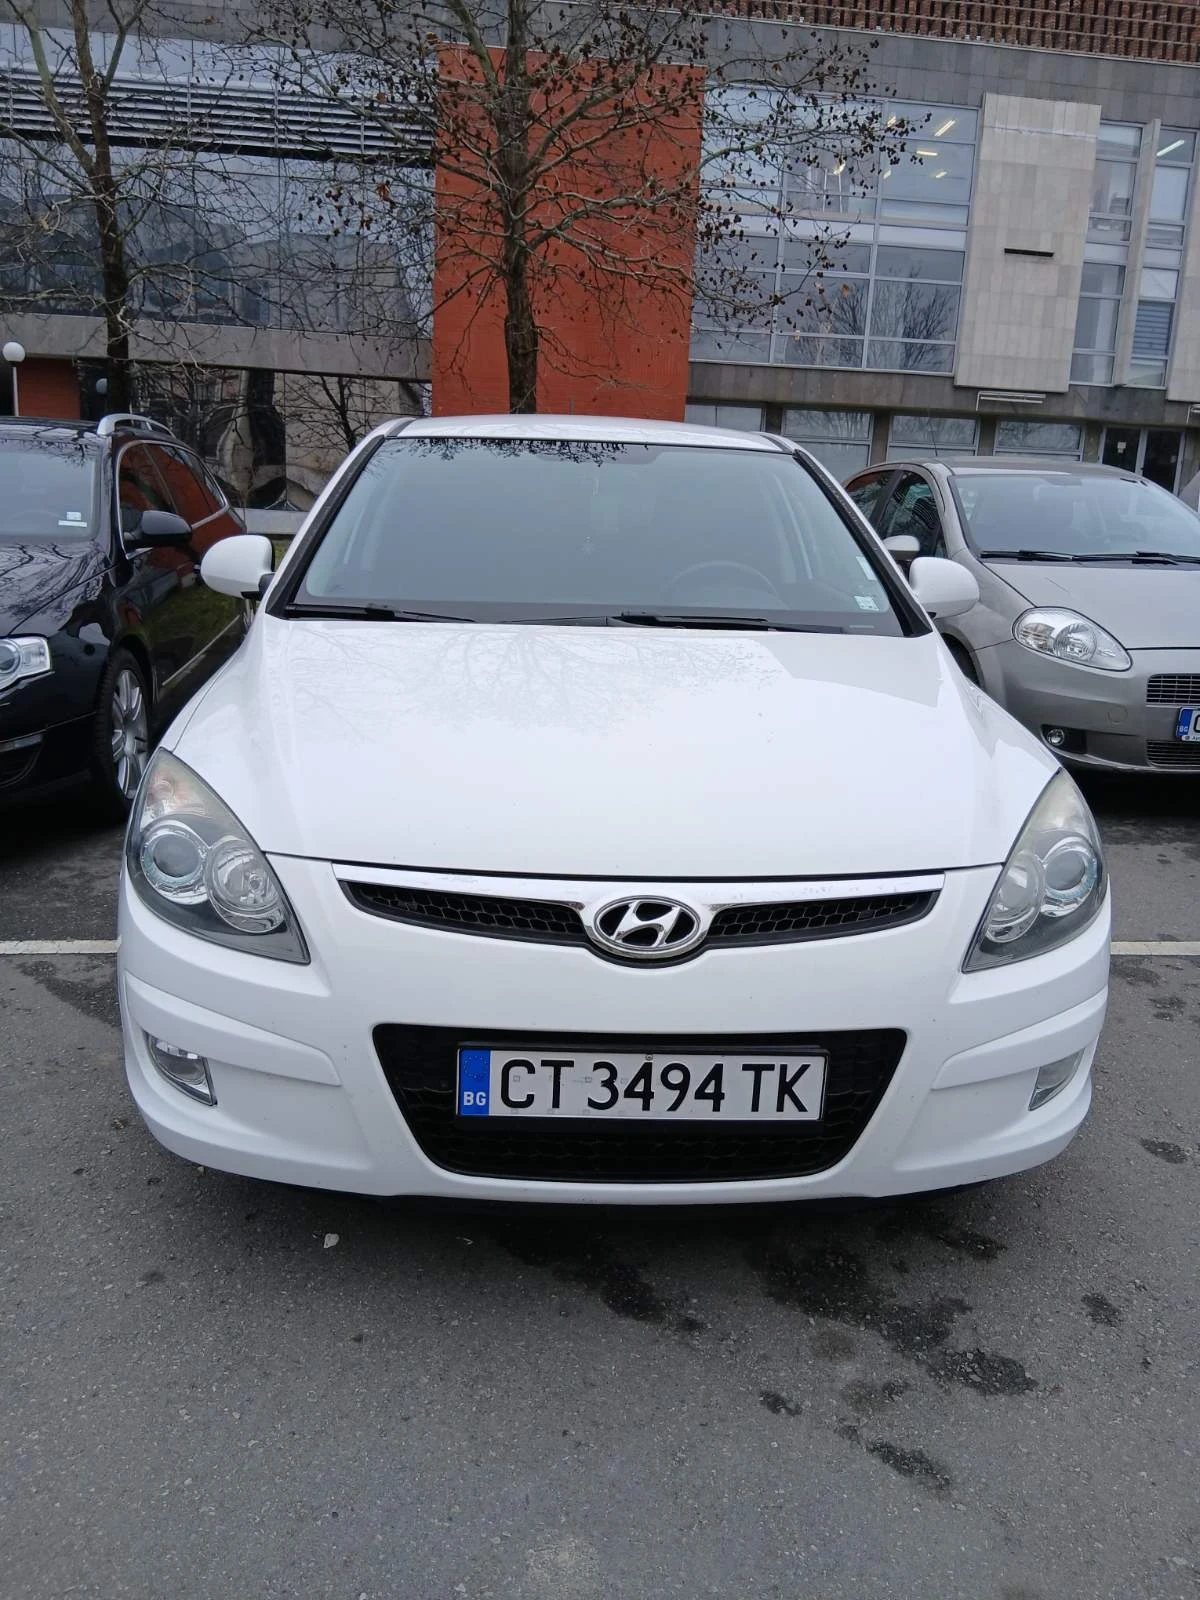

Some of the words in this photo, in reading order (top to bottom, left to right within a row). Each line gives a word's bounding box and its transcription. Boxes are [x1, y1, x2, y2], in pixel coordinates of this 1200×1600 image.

[463, 1091, 487, 1106] BG
[500, 1058, 575, 1109] CT
[587, 1060, 726, 1112] 3494
[741, 1063, 812, 1113] TK
